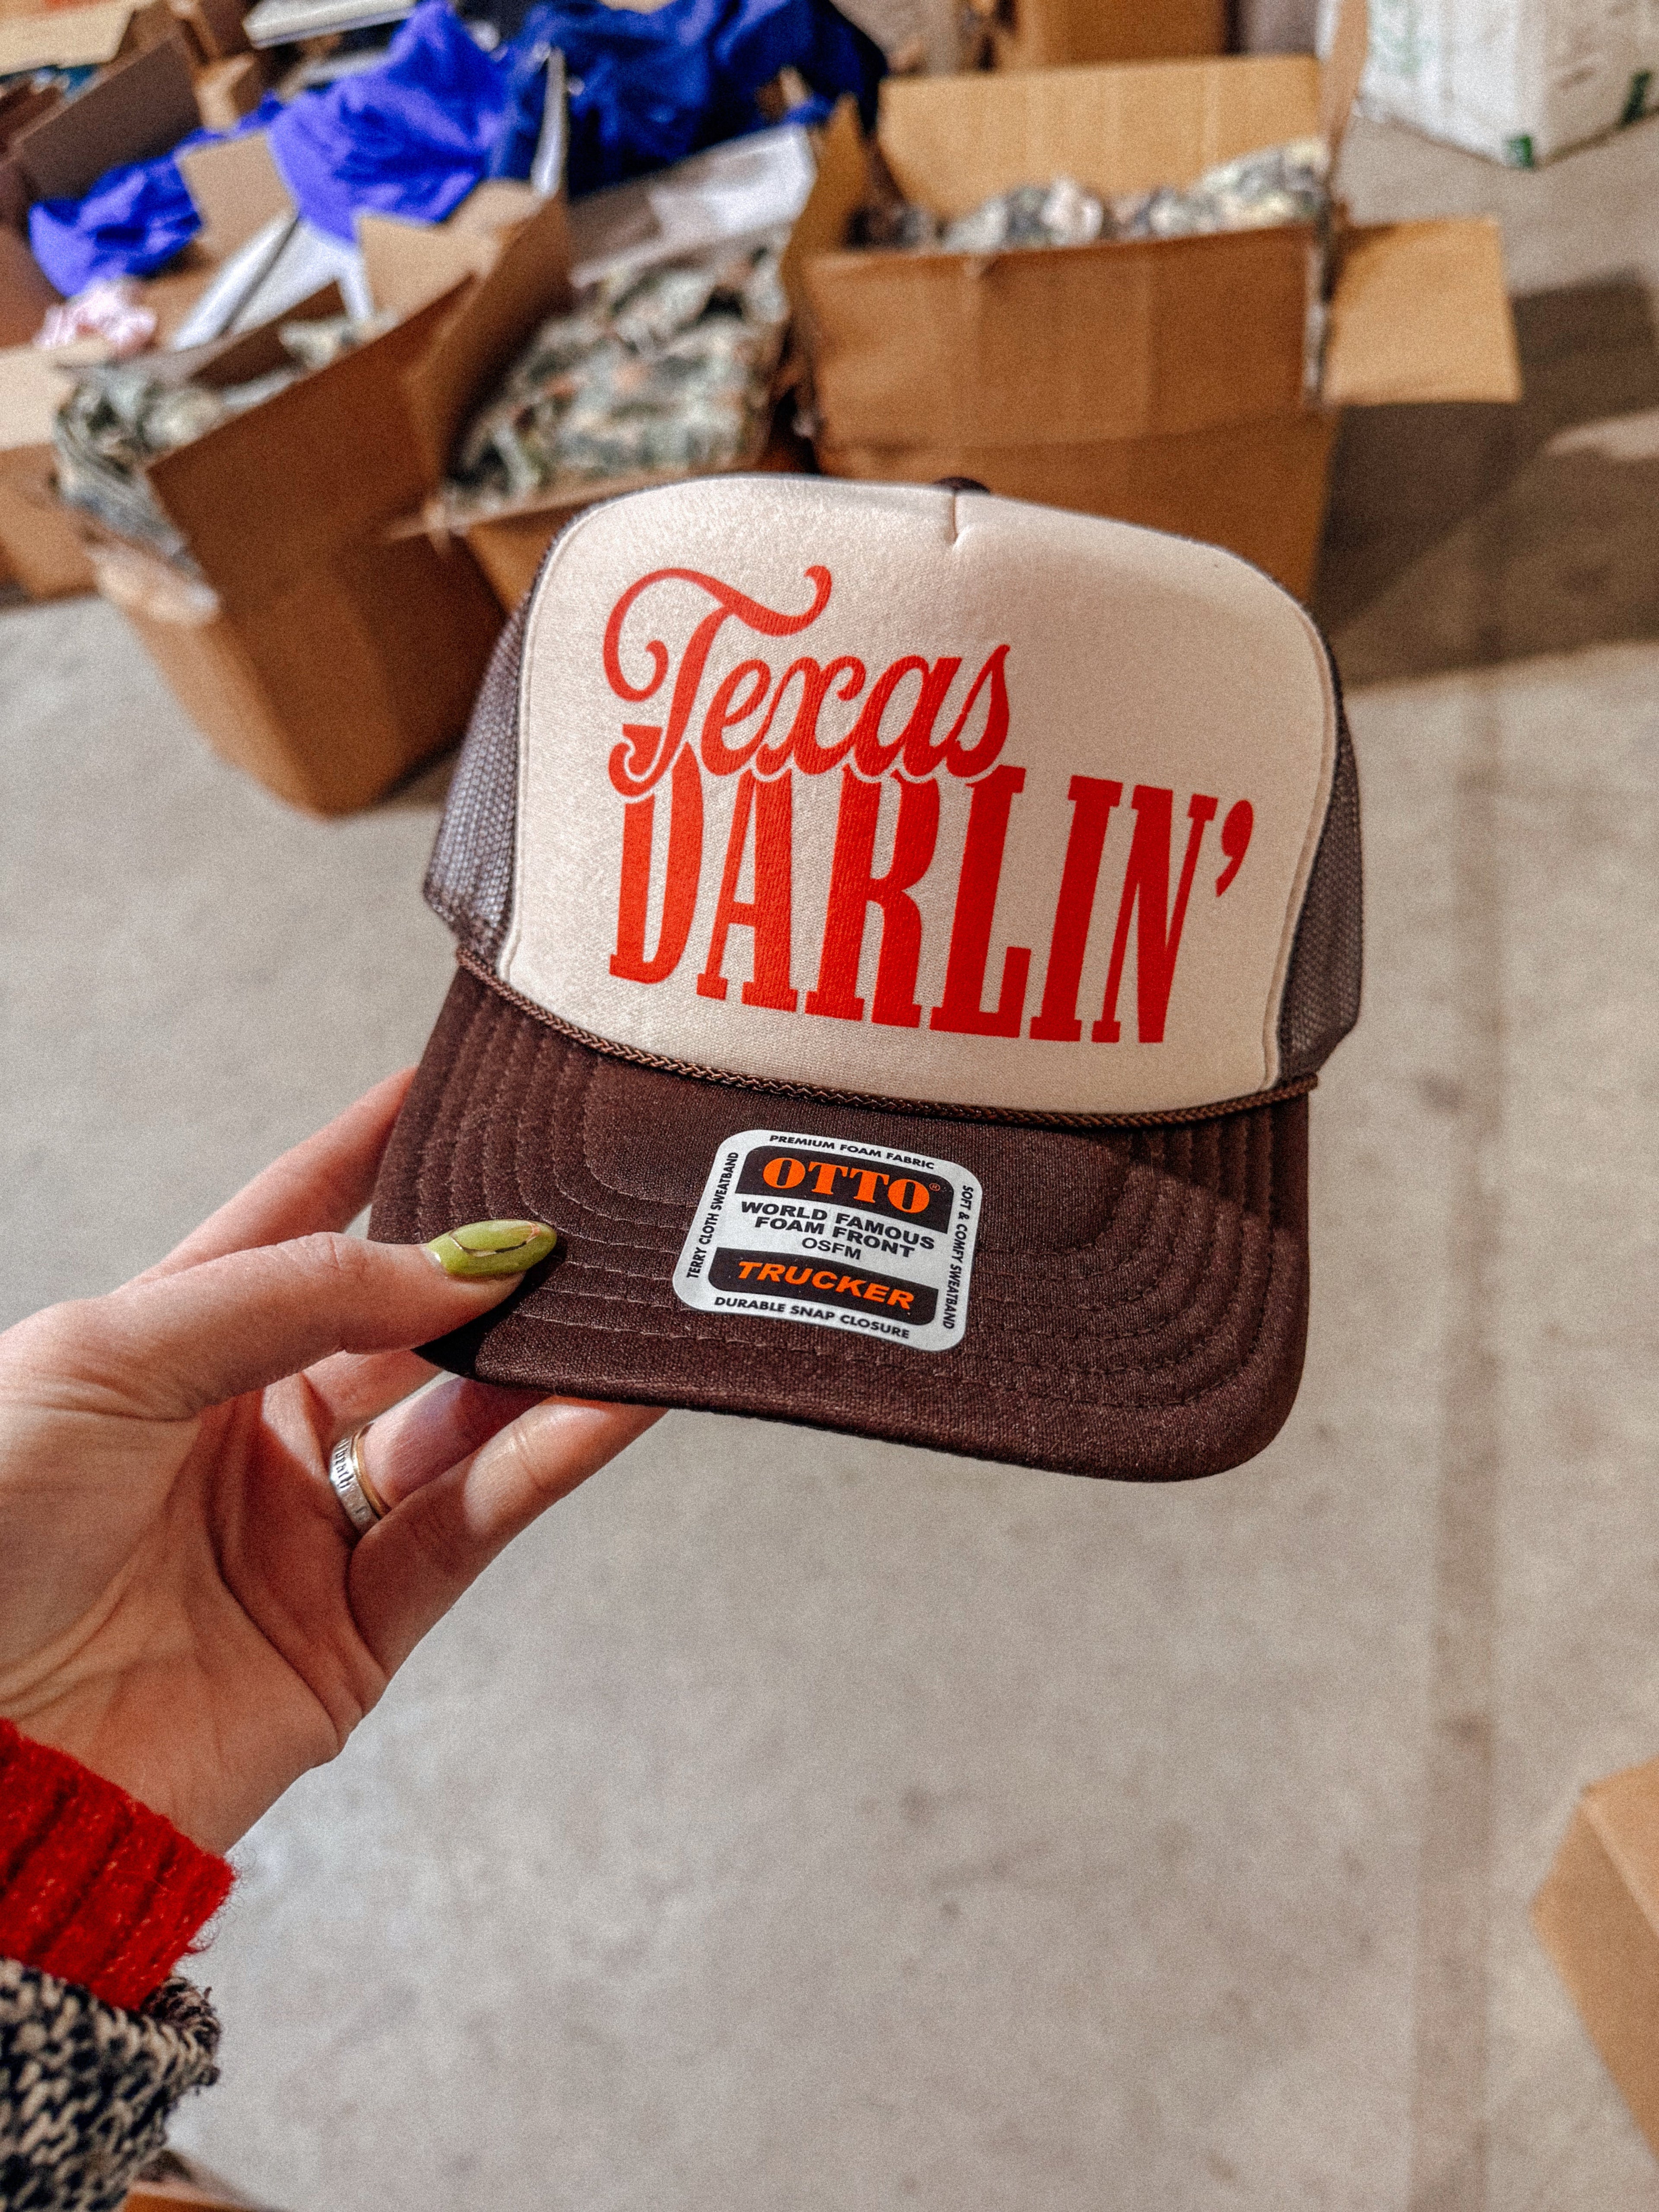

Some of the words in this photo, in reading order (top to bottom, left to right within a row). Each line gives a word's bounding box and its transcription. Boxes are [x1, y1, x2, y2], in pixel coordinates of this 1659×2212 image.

[603, 565, 1010, 798] Texas
[769, 1135, 835, 1149] PREMIUM
[840, 1144, 882, 1158] FOAM
[886, 1152, 935, 1170] FABRIC
[686, 1247, 707, 1279] TERRY
[698, 1212, 720, 1245] CLOTH
[710, 1152, 739, 1211] SWEATBAND
[958, 1211, 970, 1220] &
[960, 1185, 974, 1210] SOFT
[741, 1201, 828, 1220] WORLD
[835, 1213, 935, 1250] FAMOUS
[754, 1217, 825, 1235] FOAM
[832, 1226, 915, 1258] FRONT
[951, 1223, 969, 1264] COMFY
[801, 1237, 861, 1260] OSFM
[738, 1261, 915, 1310] TRUCKER
[943, 1264, 963, 1330] SWEATBAND
[714, 1297, 785, 1313] DURABLE
[790, 1305, 835, 1320] SNAP
[839, 1315, 910, 1339] CLOSURE
